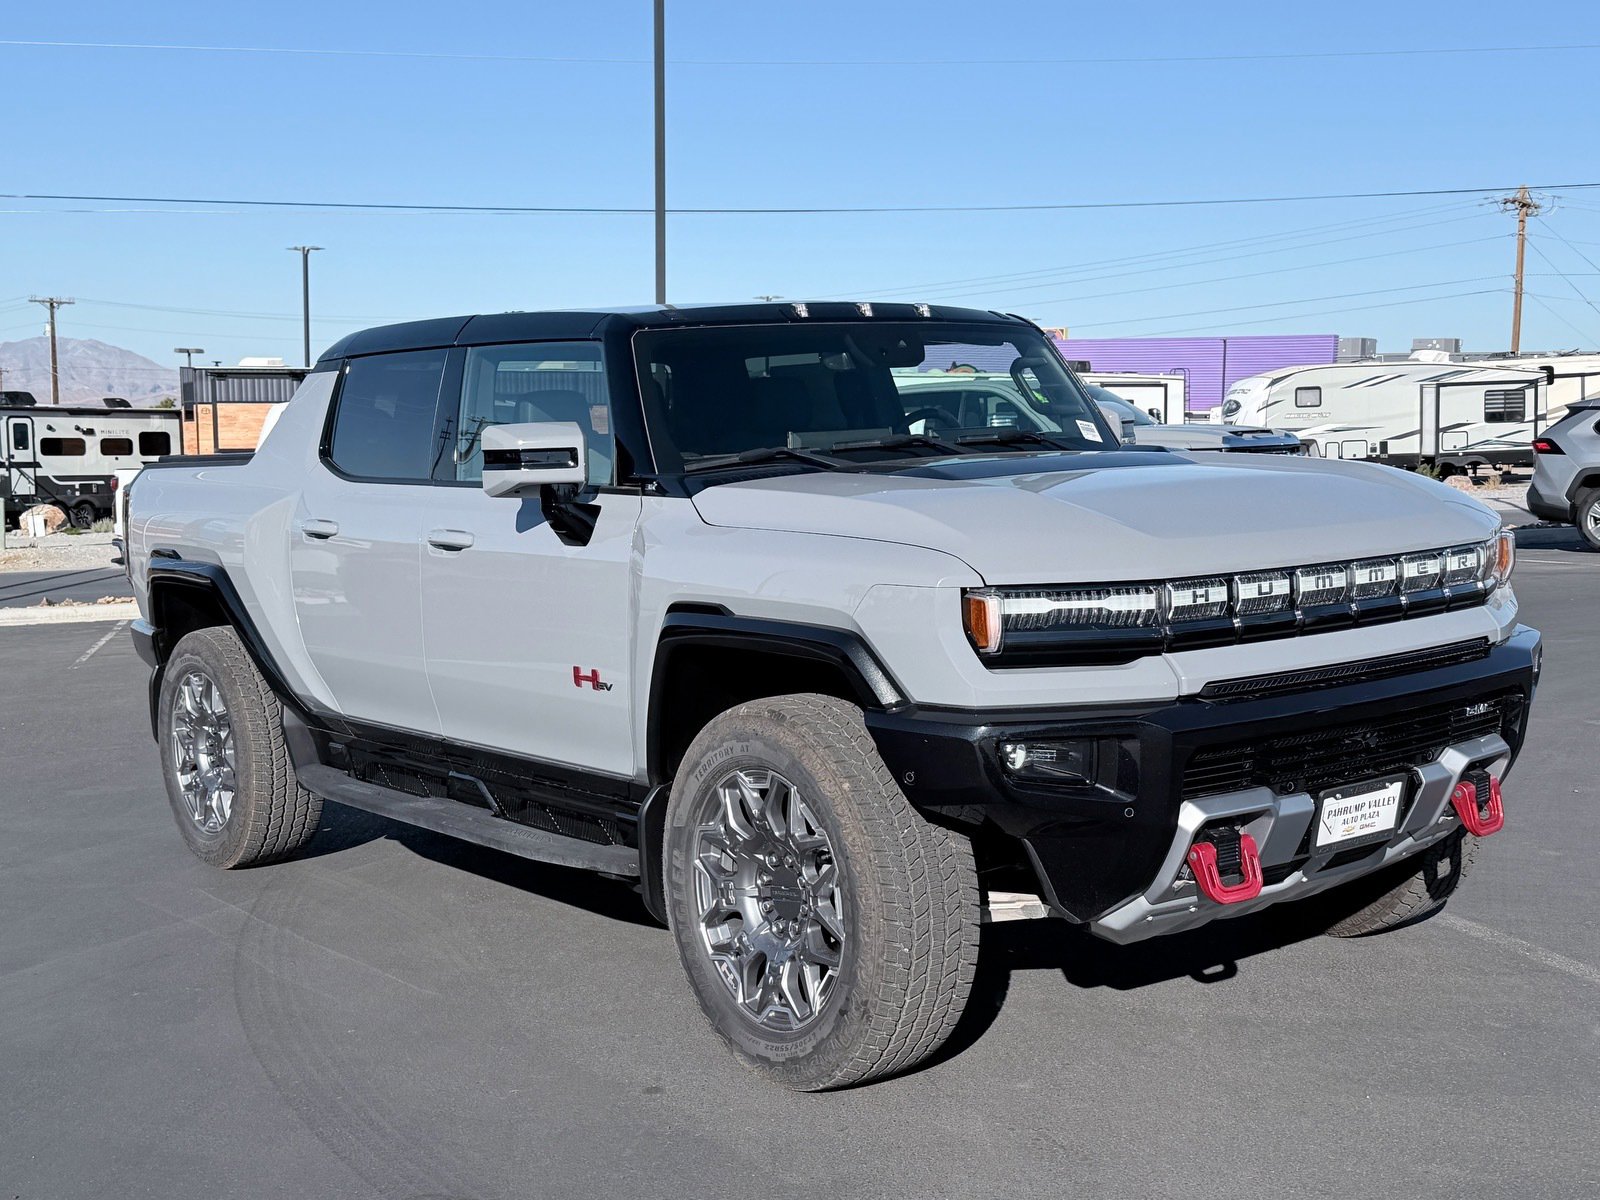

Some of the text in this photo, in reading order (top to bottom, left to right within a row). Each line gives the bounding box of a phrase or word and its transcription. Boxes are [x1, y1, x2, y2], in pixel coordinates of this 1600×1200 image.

[1192, 556, 1468, 603] HUMMER
[694, 745, 750, 782] TERRITORY AT
[1327, 796, 1397, 819] PAHRUMP VALLEY
[1341, 810, 1380, 826] AUTO PLAZA
[1360, 822, 1376, 830] GMC
